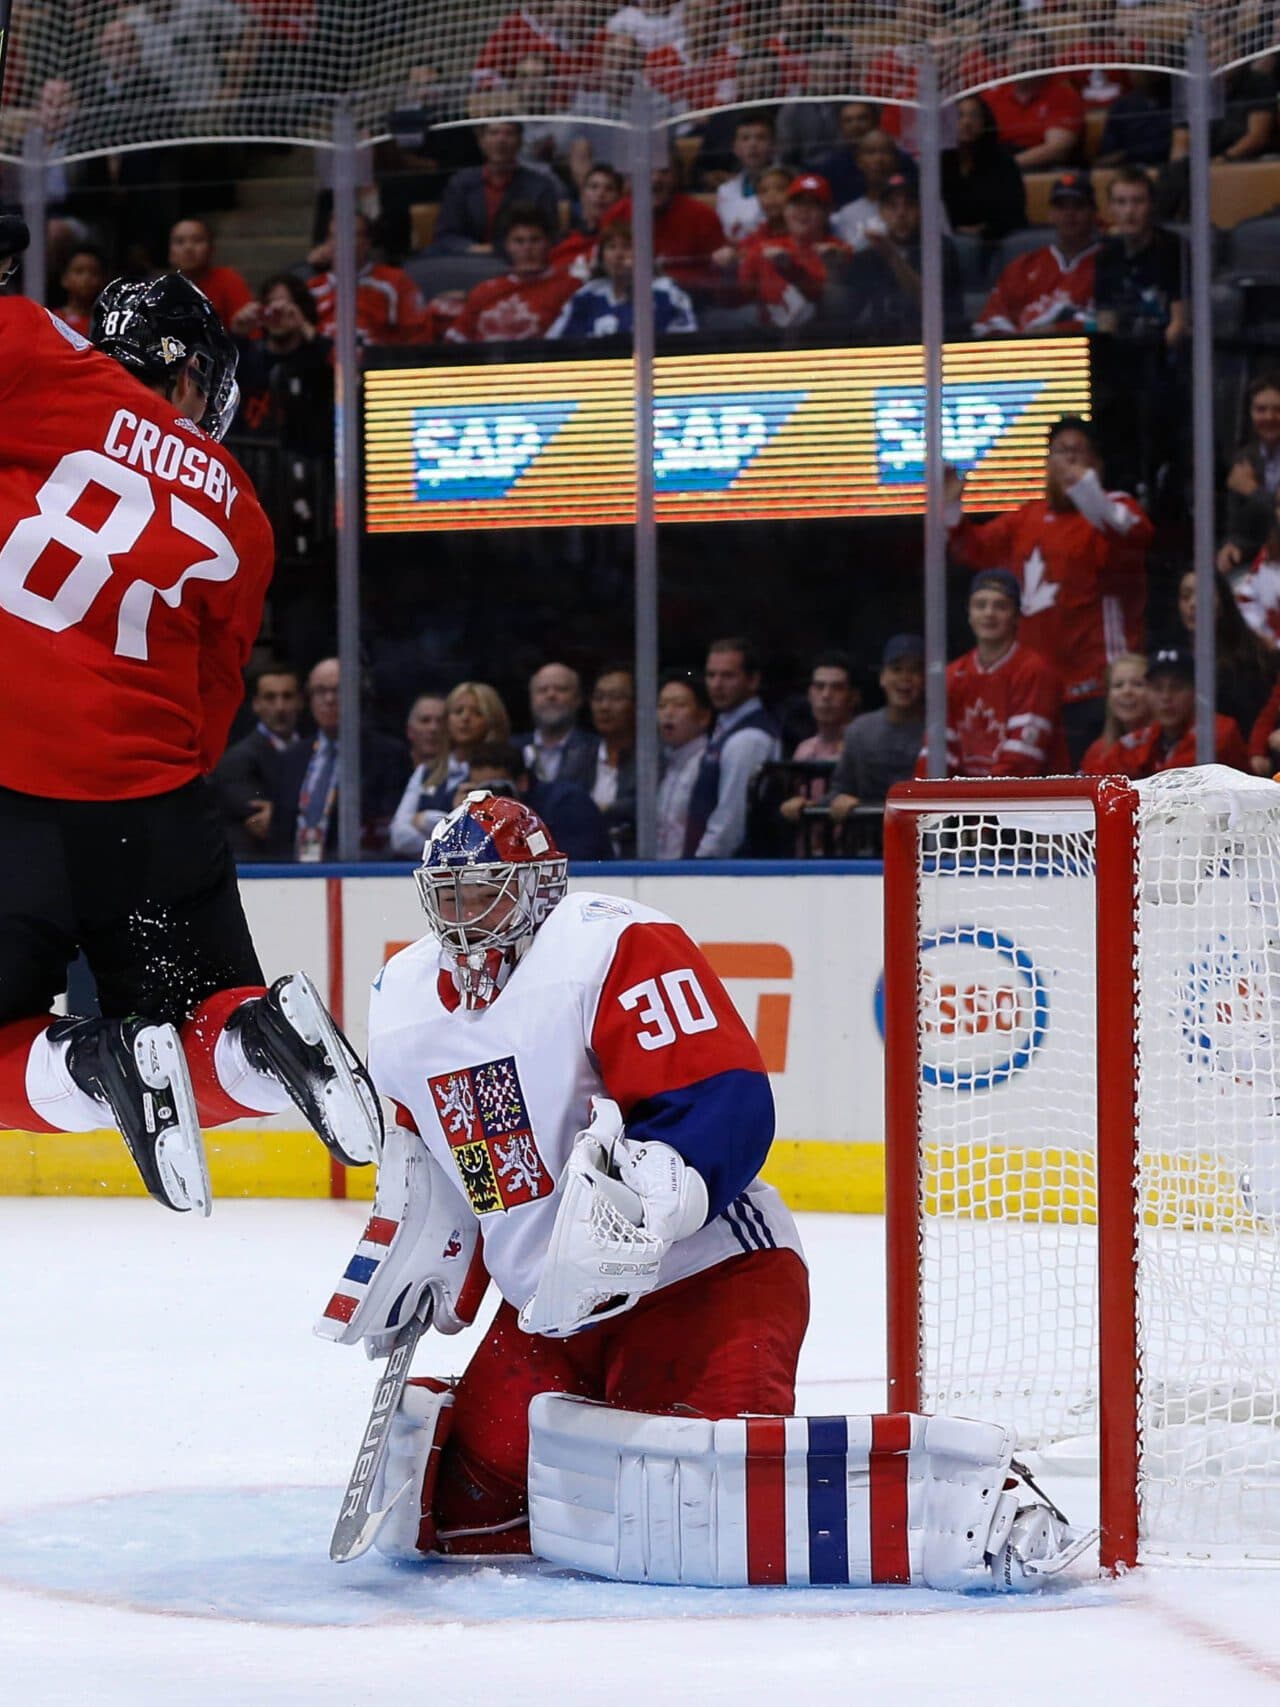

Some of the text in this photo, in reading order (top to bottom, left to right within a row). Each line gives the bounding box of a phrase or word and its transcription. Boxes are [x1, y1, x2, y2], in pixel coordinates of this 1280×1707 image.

[104, 309, 134, 336] 87
[103, 408, 239, 521] CROSBY
[414, 415, 542, 481] SAP
[618, 968, 719, 1052] 30
[340, 1344, 410, 1523] BAUER
